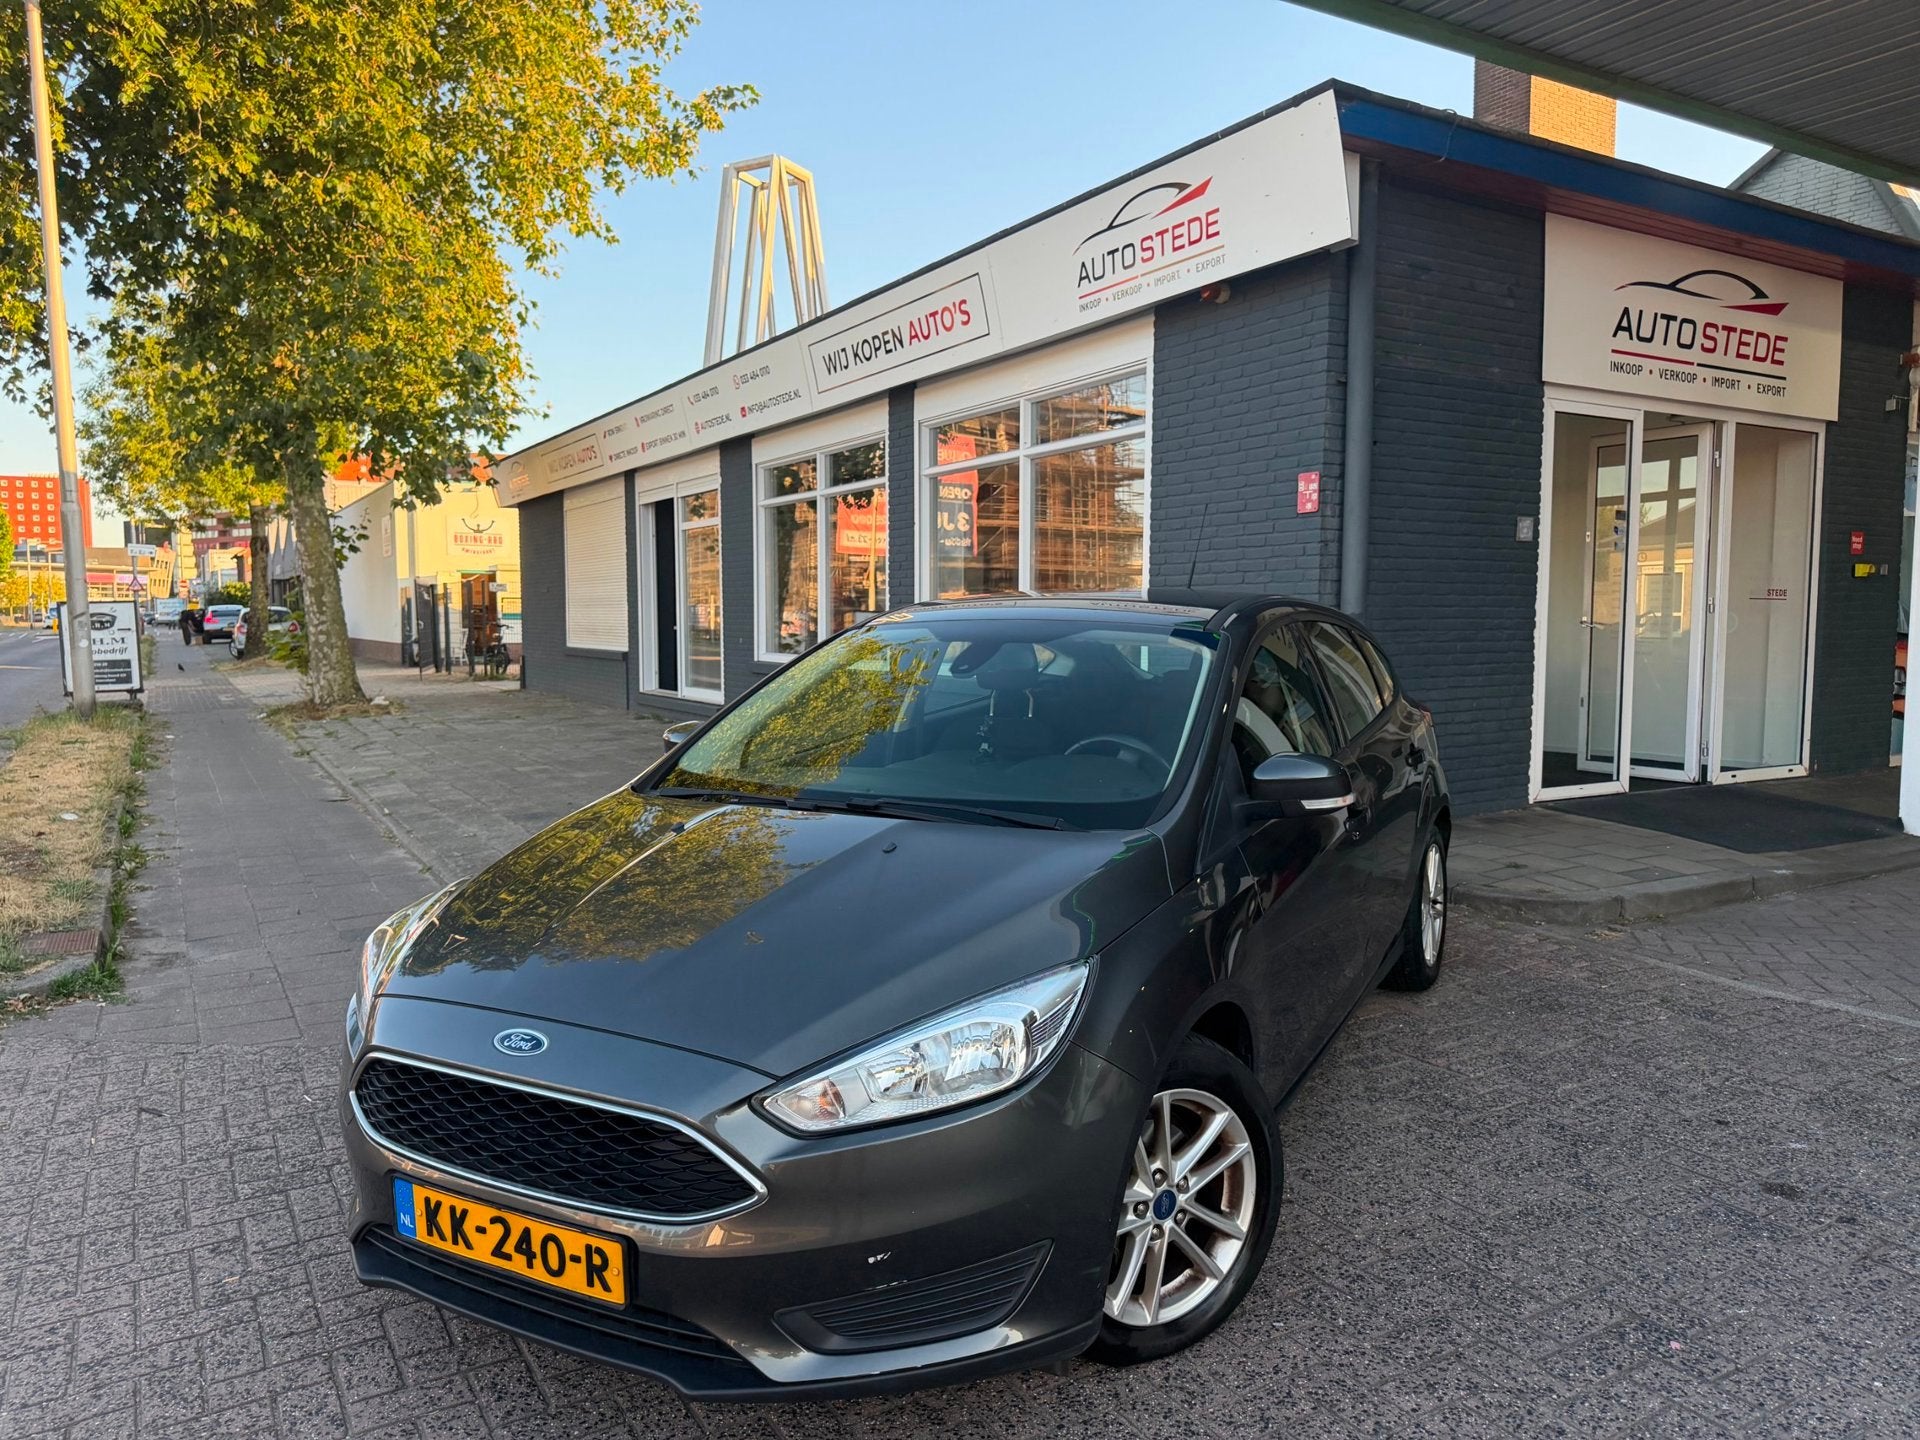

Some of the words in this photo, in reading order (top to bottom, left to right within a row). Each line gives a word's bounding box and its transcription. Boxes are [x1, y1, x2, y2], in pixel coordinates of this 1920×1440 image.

[1078, 298, 1102, 313] INKOOP
[1111, 283, 1143, 302] VERKOOP
[1153, 269, 1181, 288] IMPORT
[1195, 253, 1227, 273] EXPORT
[822, 347, 849, 376] WIJ
[851, 325, 904, 366] KOPEN
[908, 298, 971, 346] AUTO'S
[1610, 360, 1643, 376] INKOOP
[1658, 368, 1698, 384] VERKOOP
[1711, 376, 1741, 391] IMPORT
[1757, 383, 1787, 398] EXPORT
[1766, 588, 1788, 598] STEDE
[503, 1032, 536, 1051] Ford
[400, 1212, 414, 1228] NL
[424, 1195, 612, 1293] KK-240-R
